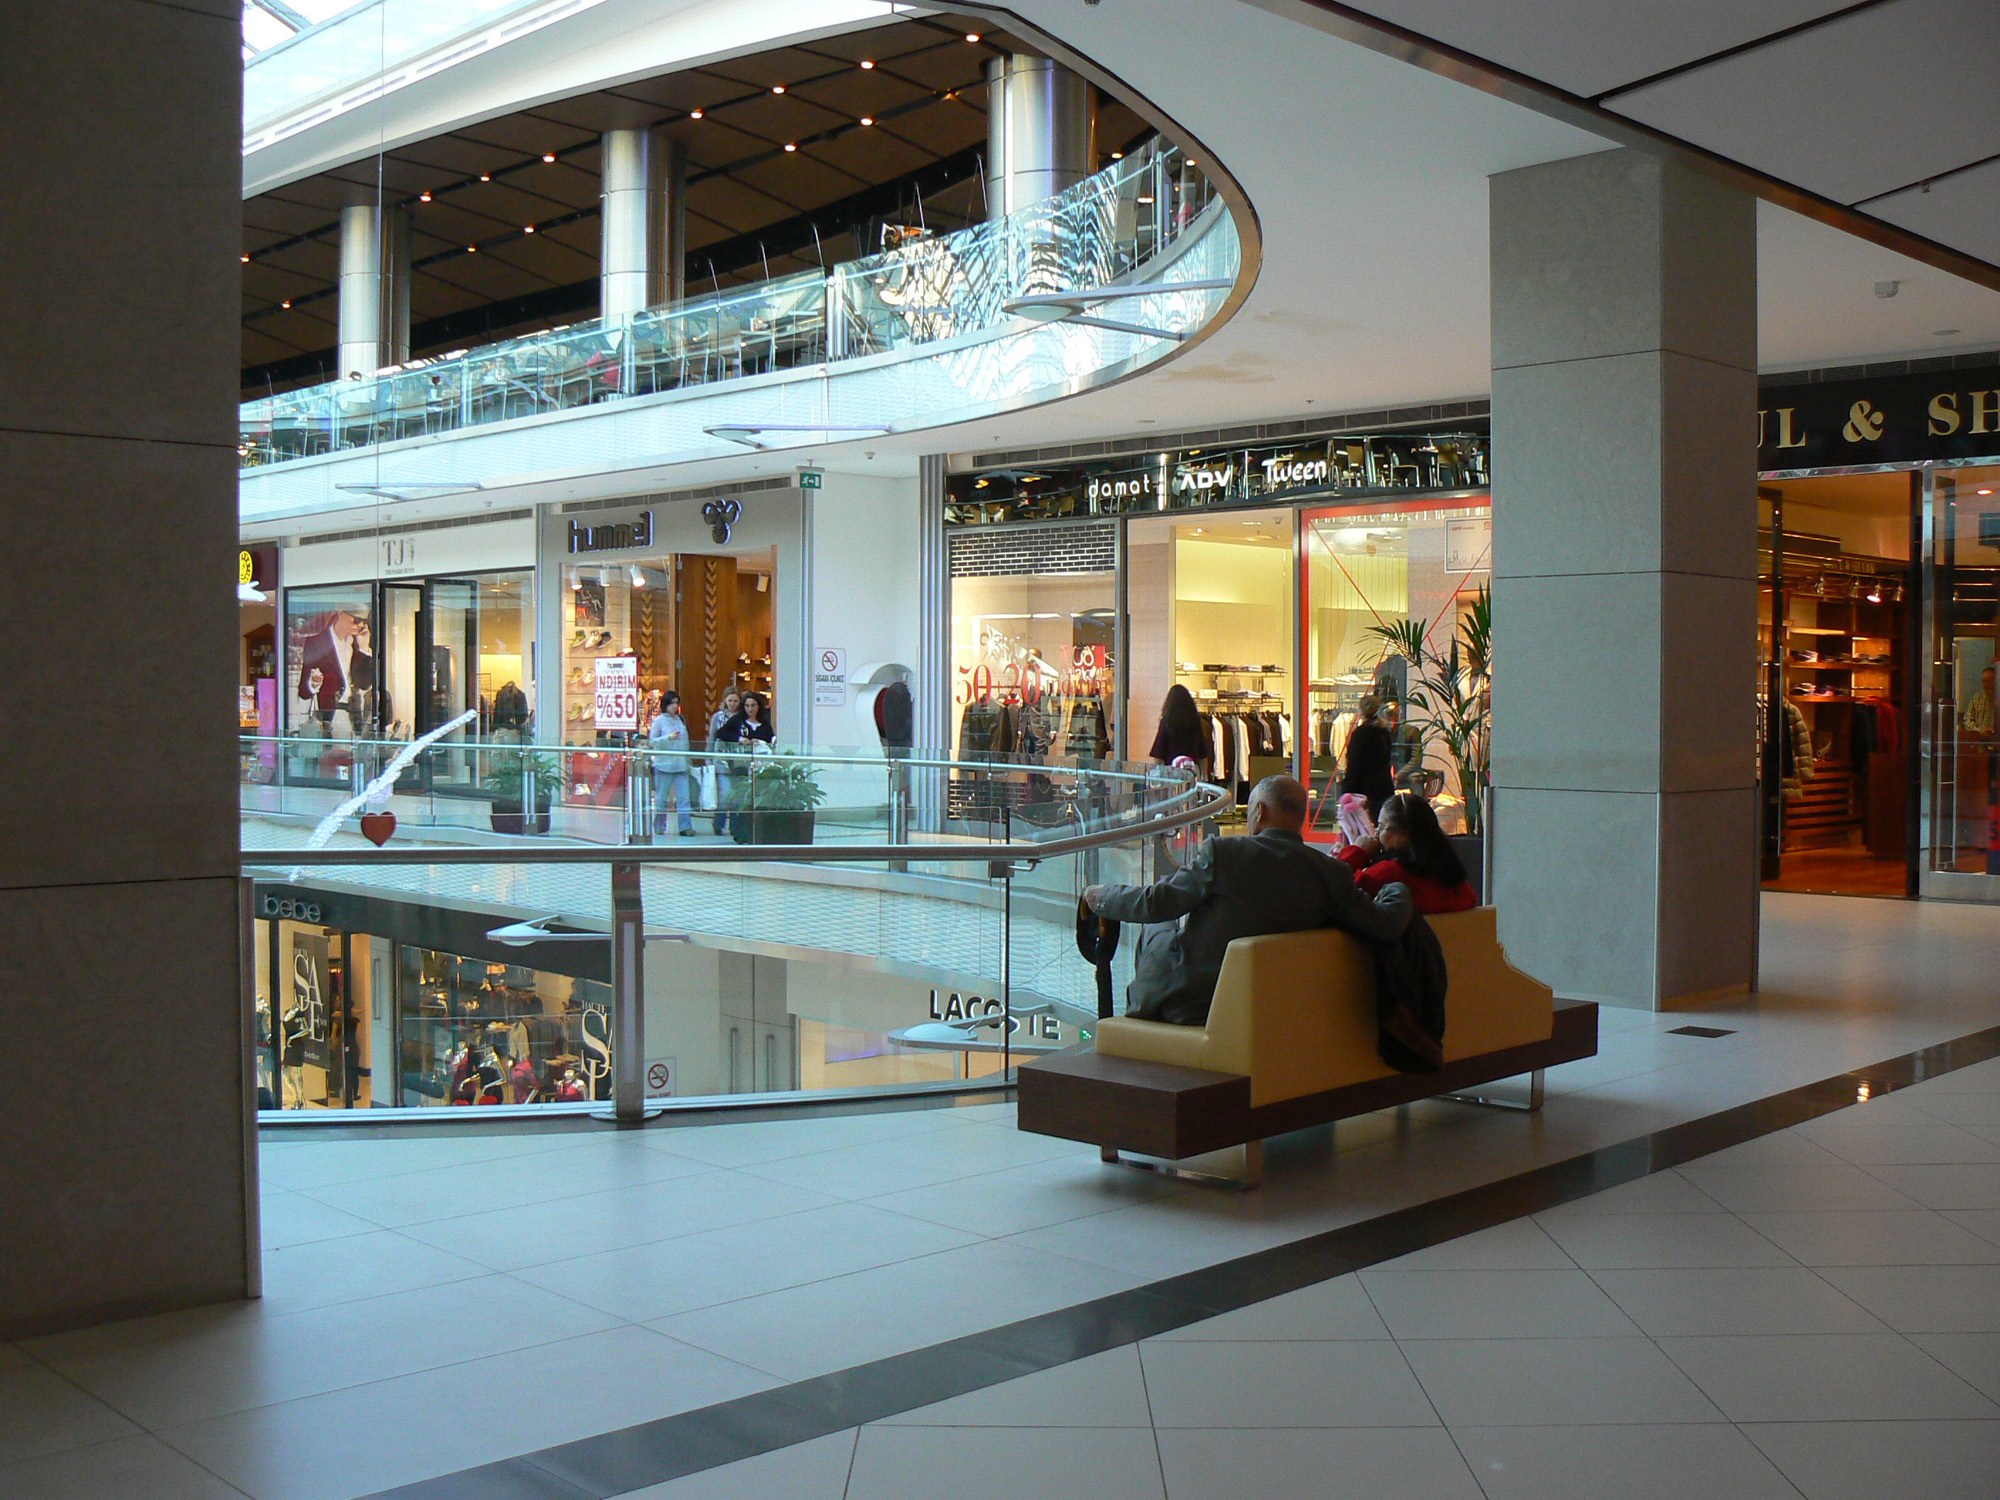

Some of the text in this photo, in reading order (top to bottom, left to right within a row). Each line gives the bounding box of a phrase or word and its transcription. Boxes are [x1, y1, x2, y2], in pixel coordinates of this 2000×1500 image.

[1842, 400, 1884, 443] &
[1088, 458, 1327, 498] damat ADV Tween
[568, 511, 653, 554] hummel
[382, 540, 404, 566] TJ
[597, 694, 635, 718] %50
[264, 894, 321, 923] bebe
[304, 1051, 320, 1061] bebe
